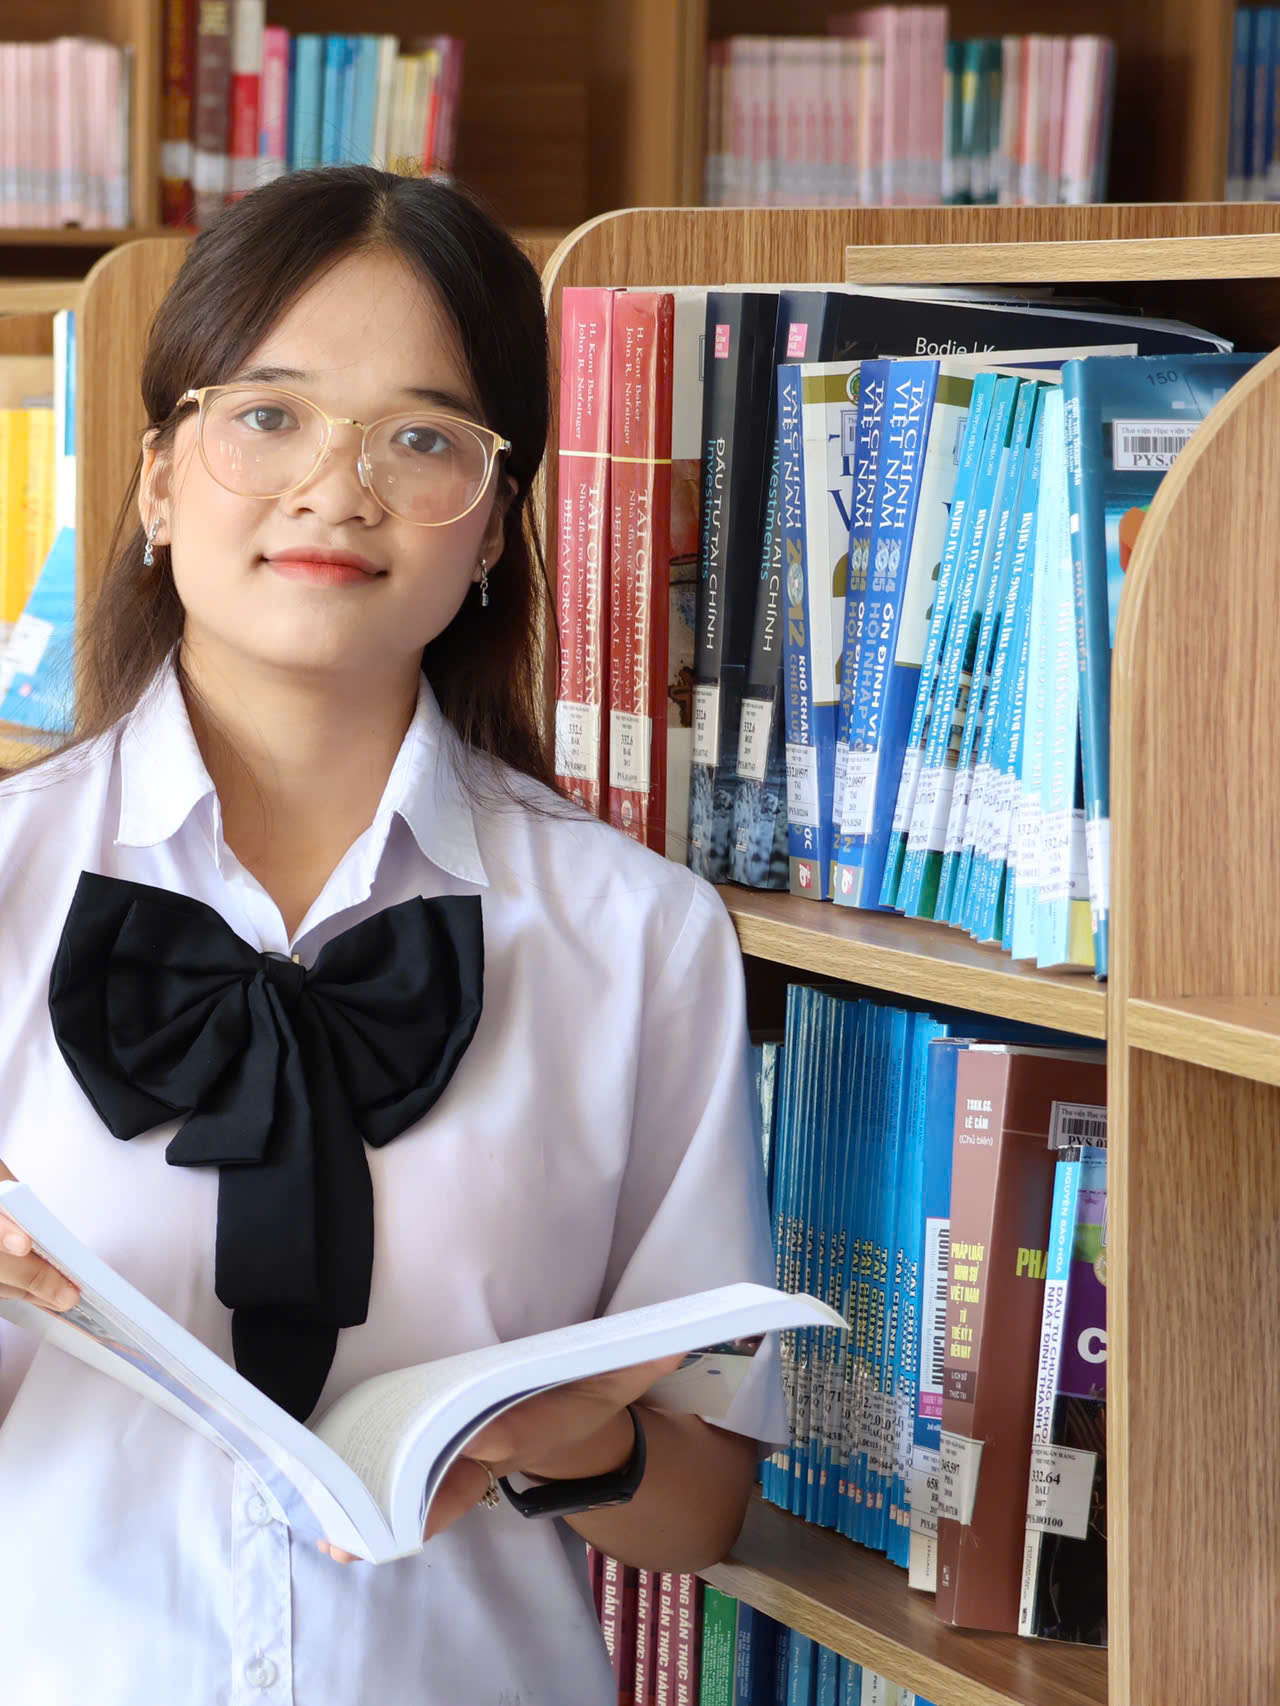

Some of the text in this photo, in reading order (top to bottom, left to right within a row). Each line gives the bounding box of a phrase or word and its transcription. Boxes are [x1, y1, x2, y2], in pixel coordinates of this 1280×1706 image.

[590, 323, 596, 338] H.
[626, 327, 634, 357] John
[637, 327, 644, 341] H.
[915, 337, 967, 355] Bodie
[576, 323, 586, 439] John R. Nofsinger
[625, 363, 632, 377] R.
[1146, 370, 1178, 386] 150
[782, 384, 794, 528] VIỆT NAM
[792, 432, 801, 528] CHÍNH
[855, 382, 875, 528] VIỆT NAM
[865, 380, 884, 528] TÀI CHÍNH
[879, 378, 912, 528] VIỆT NAM
[894, 380, 925, 529] TÀI CHÍNH
[1133, 455, 1176, 466] PYS.0
[702, 440, 716, 579] Investments
[561, 499, 572, 638] BEHAVIORAL
[576, 569, 585, 611] Doanh
[585, 542, 601, 632] CHÍNH
[612, 505, 621, 648] BEHAVIORAL
[626, 576, 634, 620] Doanh
[634, 490, 651, 639] TÀI CHÍNH
[786, 538, 805, 648] 2012
[872, 538, 889, 592] 2015
[706, 574, 718, 649] CHÍNH
[763, 575, 780, 651] CHÍNH
[911, 499, 966, 732] trình ĐẠI CƯƠNG THỊ TRƯỜNG TÀI CHÍNH
[936, 508, 988, 743] trình ĐẠI CƯƠNG THỊ TRƯỜNG TÀI CHÍNH
[982, 510, 1034, 747] trình ĐẠI CƯƠNG THỊ TRƯỜNG TÀI CHÍNH
[624, 627, 632, 673] nghiệp
[858, 603, 880, 718] HỘI NHẬP
[872, 645, 887, 708] ĐỊNH
[959, 1134, 993, 1146] (Chủ biên)
[965, 1116, 988, 1129] LÊ CẢM
[951, 1241, 984, 1261] PHÁP LUẬT
[969, 1262, 979, 1285] SỰ
[876, 1248, 888, 1357] TÀI CHÍNH
[888, 1248, 904, 1358] TÀI CHÍNH
[905, 1262, 918, 1373] TÀI CHÍNH
[951, 1283, 979, 1304] VIỆT NAM
[1032, 1470, 1061, 1485] 332.64
[604, 1585, 620, 1616] DẪN
[657, 1595, 673, 1668] DẪN THỰC
[635, 1588, 649, 1703] DẪN THỰC HÀNH
[677, 1607, 693, 1681] DẪN THỰC
